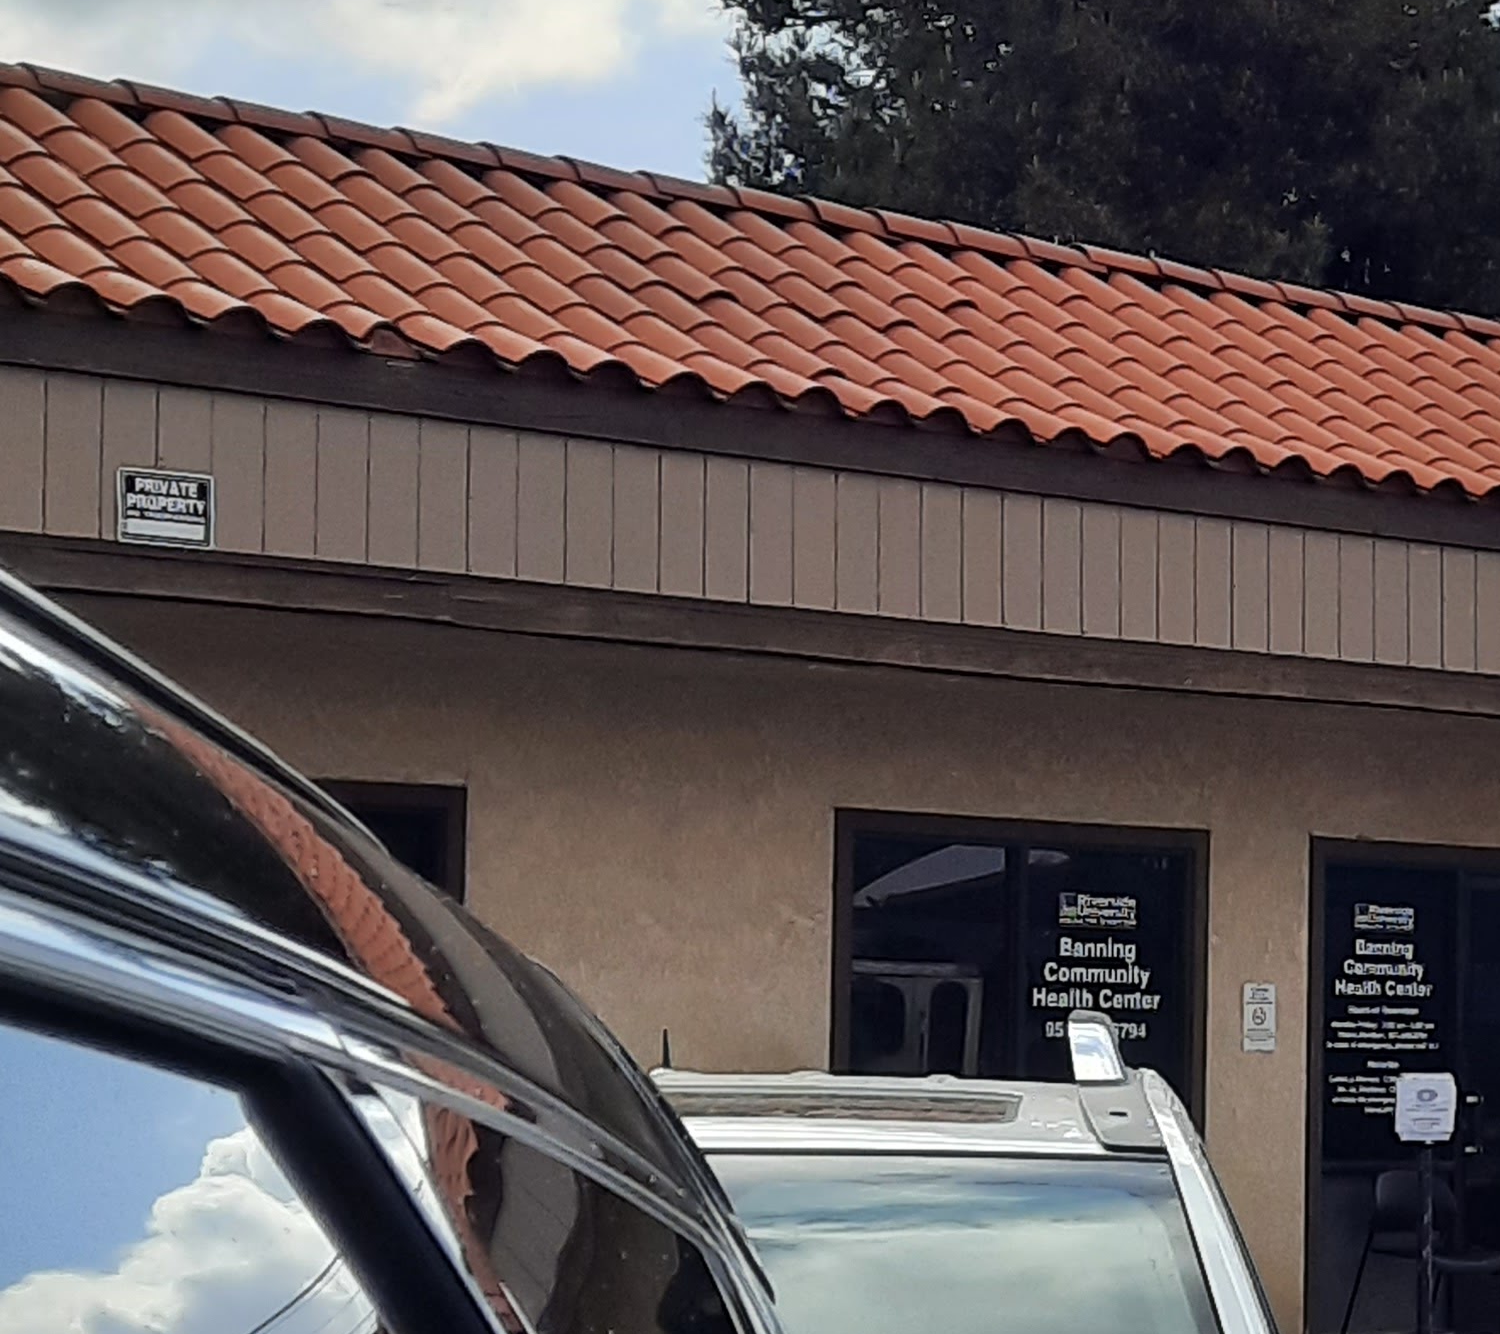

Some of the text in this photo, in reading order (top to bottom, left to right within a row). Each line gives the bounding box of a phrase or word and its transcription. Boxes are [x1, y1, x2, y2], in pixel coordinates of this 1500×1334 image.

[134, 477, 199, 498] PRIVATE
[126, 492, 206, 515] PROPERTY
[1060, 936, 1136, 963] Banning
[1043, 962, 1150, 989] Community
[1343, 959, 1424, 981] Community
[1032, 988, 1160, 1009] Health Center
[1335, 979, 1433, 997] Health Center
